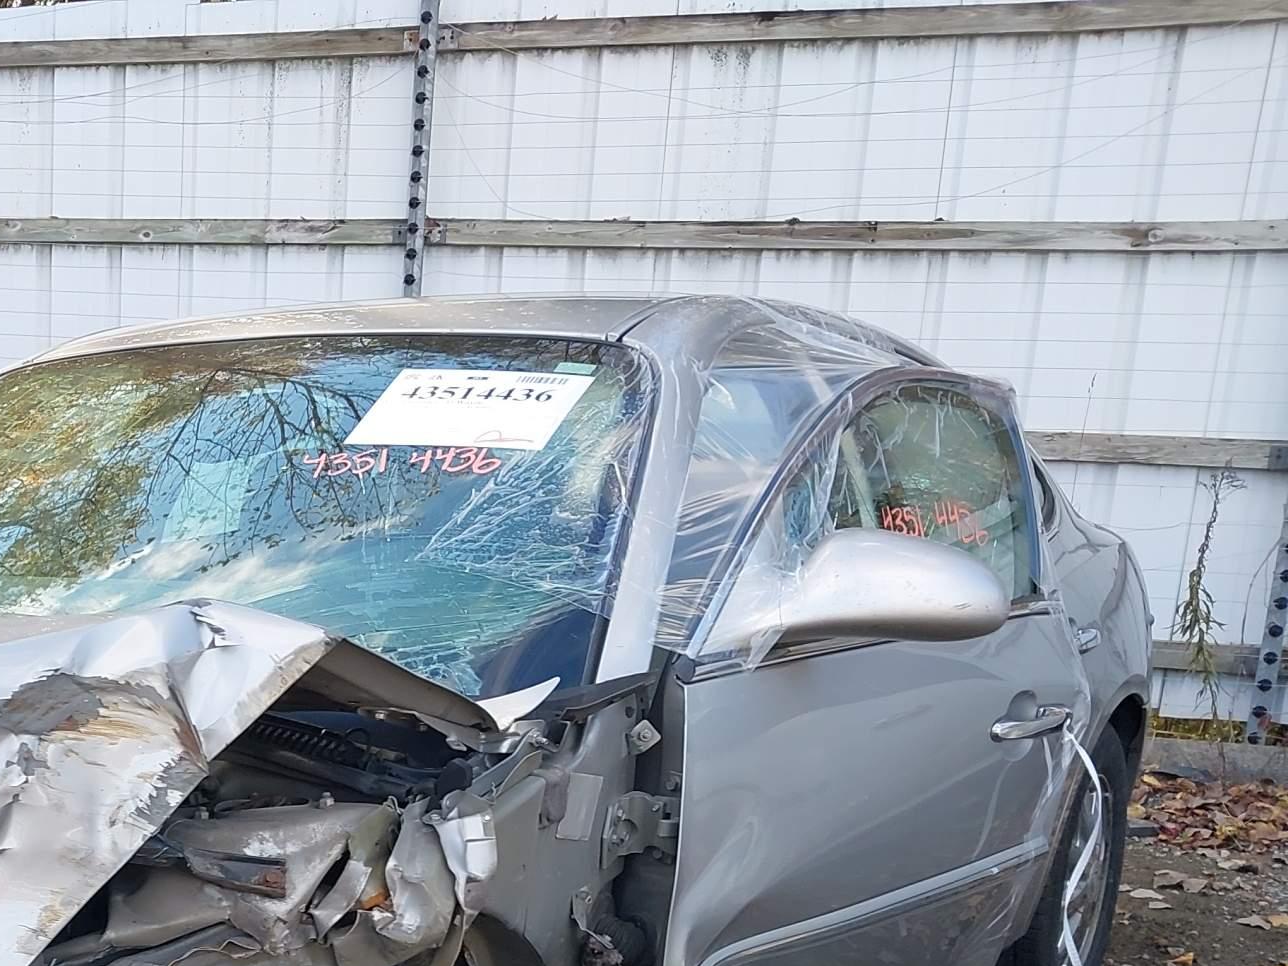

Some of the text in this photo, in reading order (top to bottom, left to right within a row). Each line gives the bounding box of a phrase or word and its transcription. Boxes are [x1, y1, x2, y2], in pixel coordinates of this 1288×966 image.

[402, 385, 558, 402] 43514436
[303, 447, 502, 478] 4351 4436
